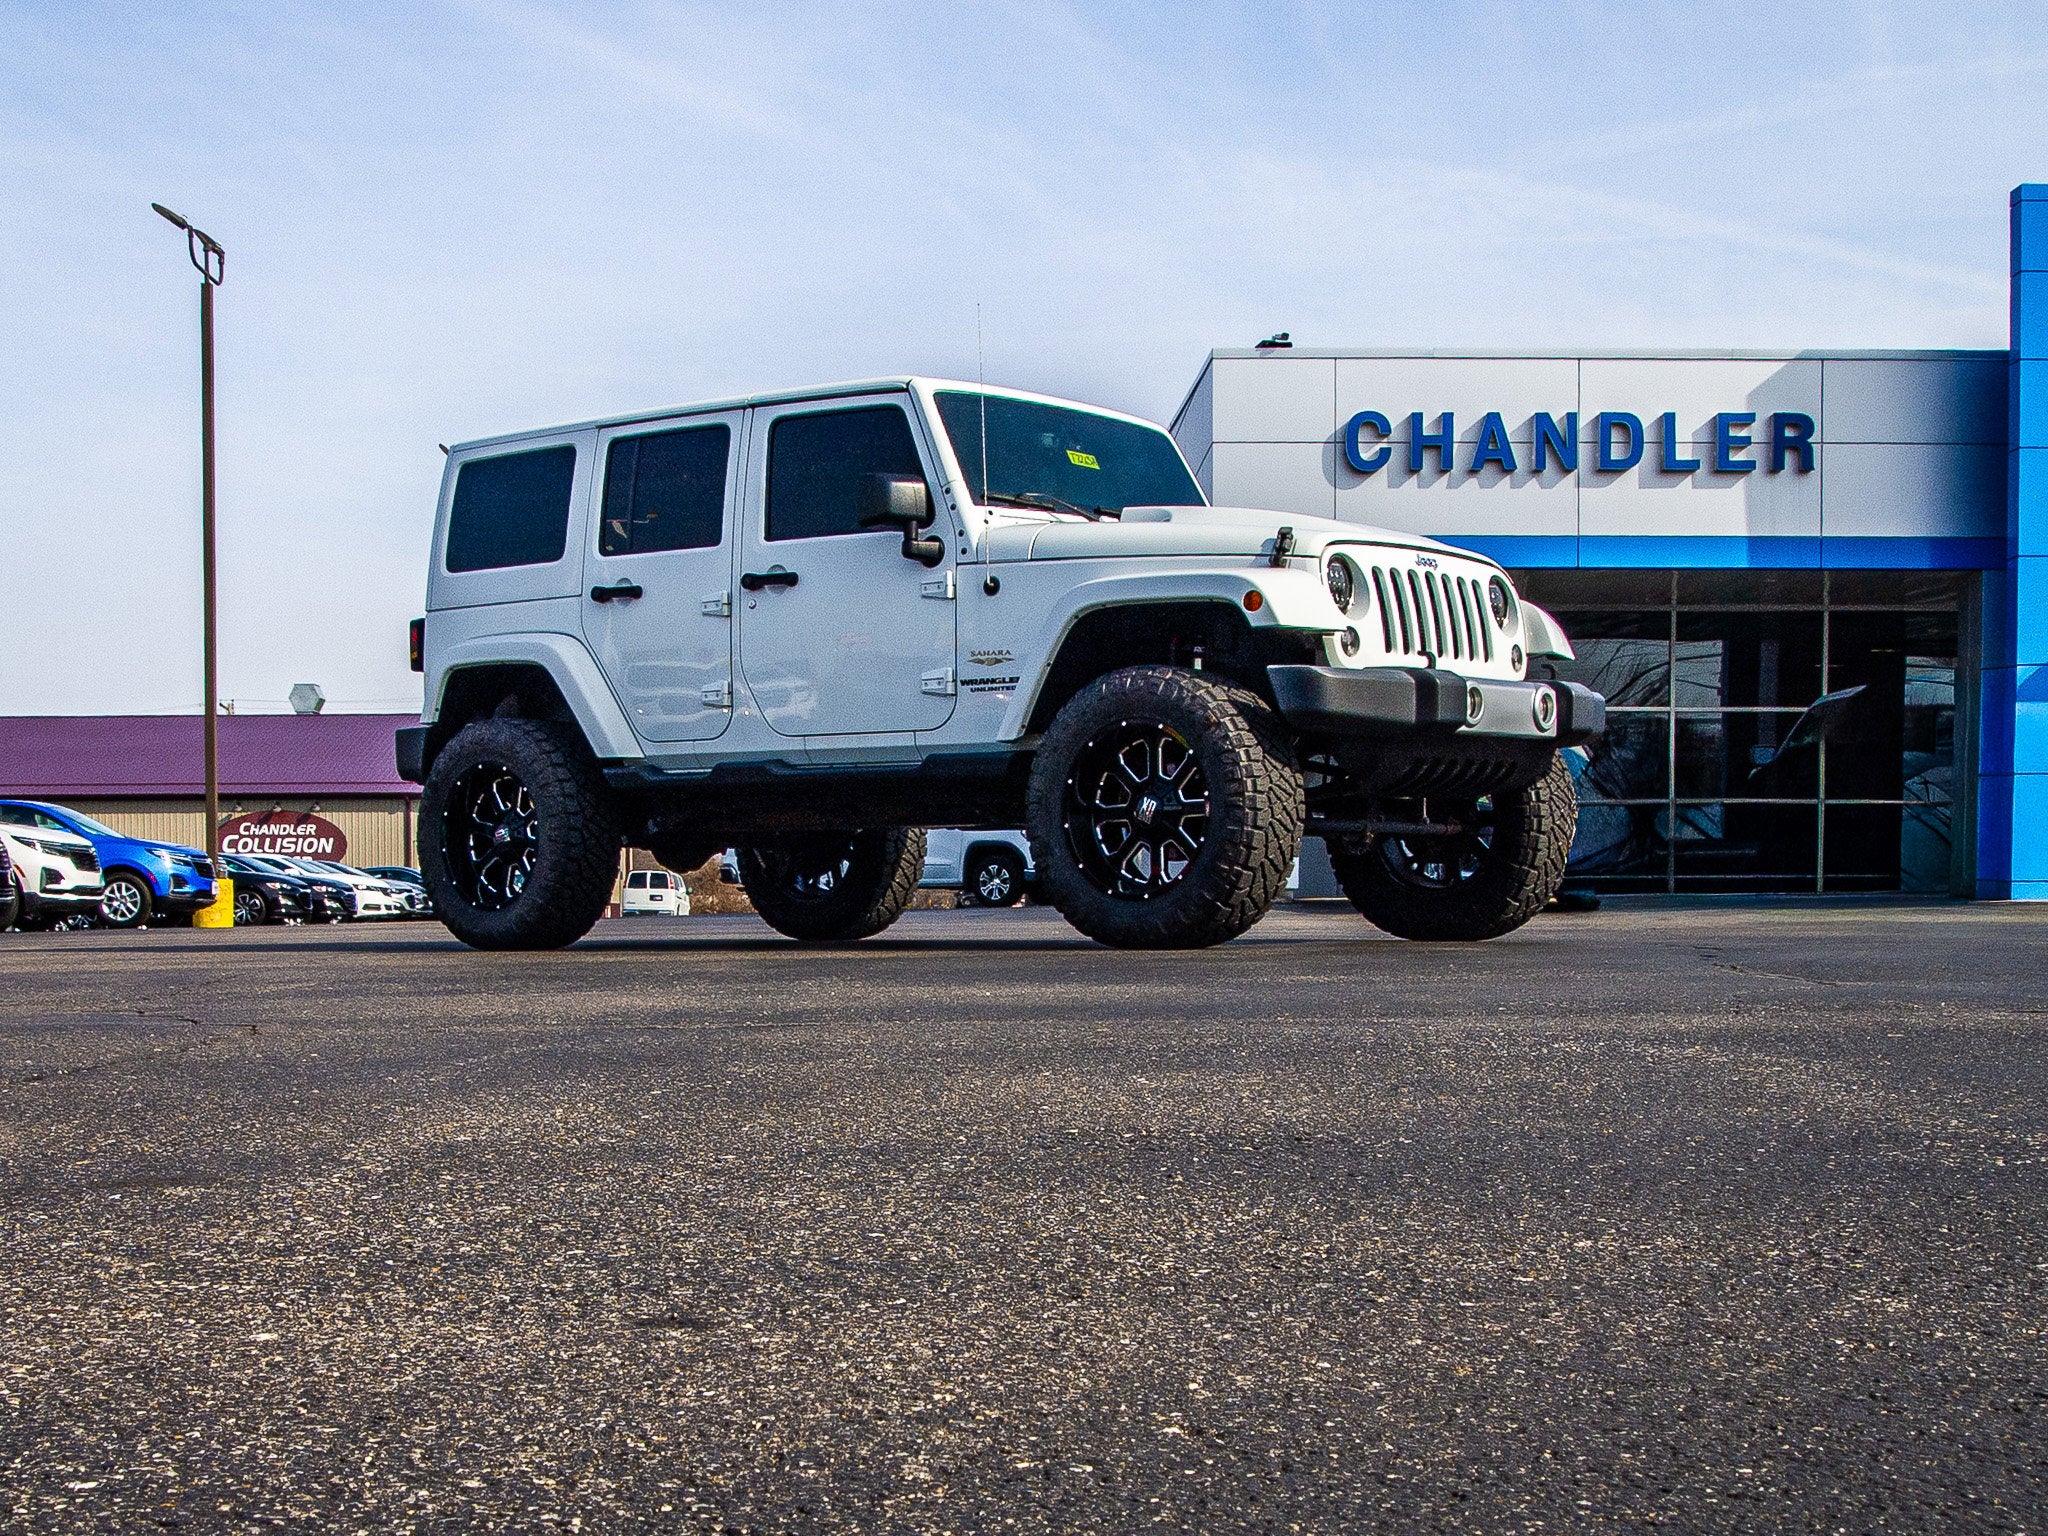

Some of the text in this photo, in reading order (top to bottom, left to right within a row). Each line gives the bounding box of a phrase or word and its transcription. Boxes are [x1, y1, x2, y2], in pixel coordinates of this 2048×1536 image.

[1345, 411, 1816, 472] CHANDLER
[970, 649, 1012, 657] SAHARA
[970, 685, 1017, 693] UNLIMITED
[239, 822, 317, 836] CHANDLER
[221, 834, 334, 853] COLLISION
